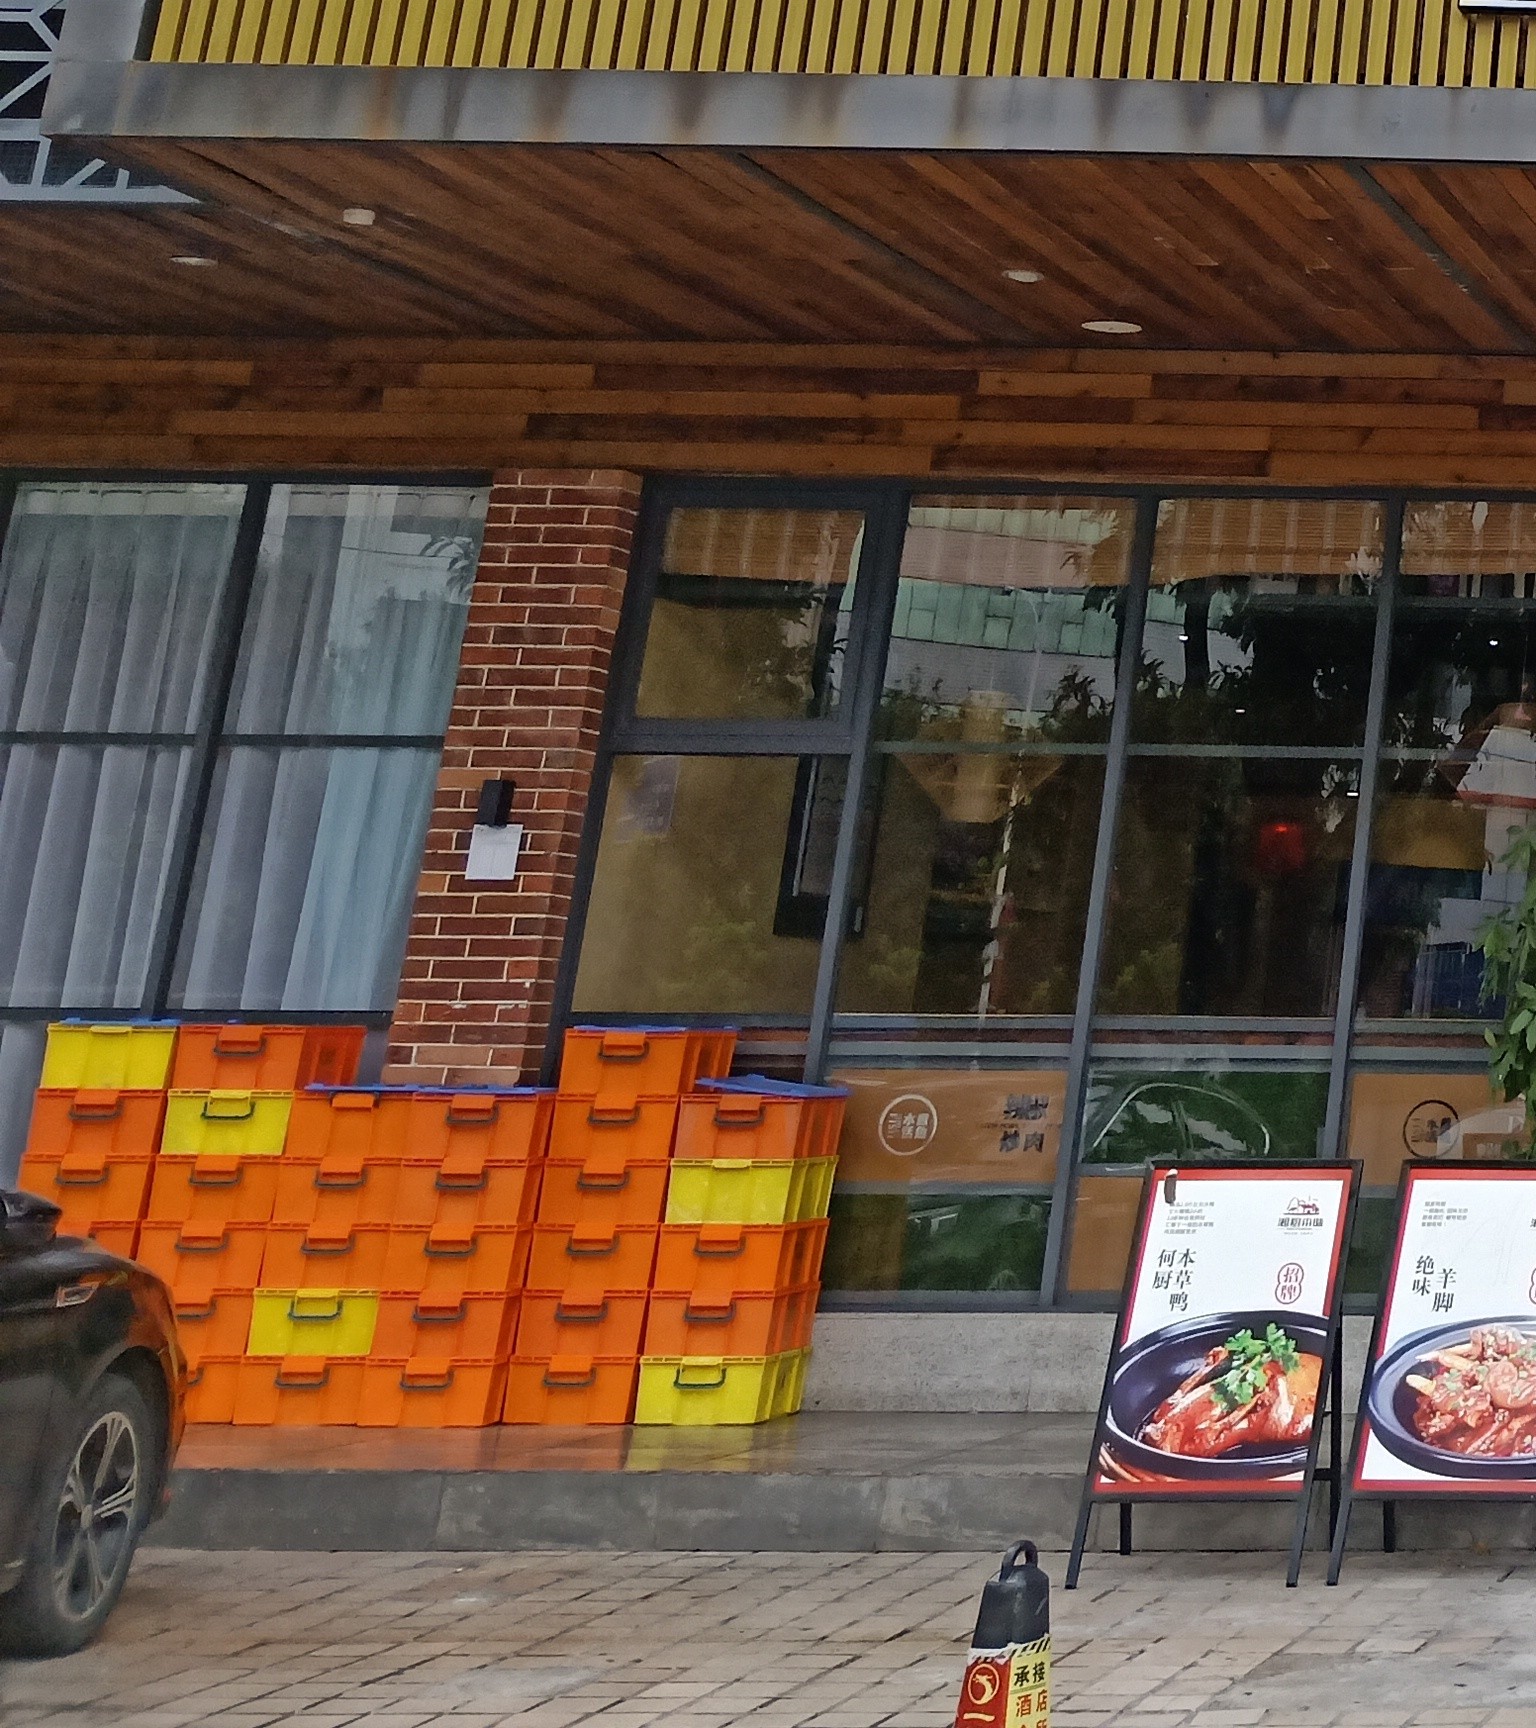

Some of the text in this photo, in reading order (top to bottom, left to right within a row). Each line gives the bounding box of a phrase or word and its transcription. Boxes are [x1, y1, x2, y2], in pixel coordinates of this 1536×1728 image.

[1280, 1266, 1301, 1301] 招牌
[1412, 1255, 1435, 1297] 绝味
[1432, 1268, 1457, 1313] 羊脚
[1013, 1661, 1046, 1687] 承接
[1015, 1689, 1048, 1718] 酒店
